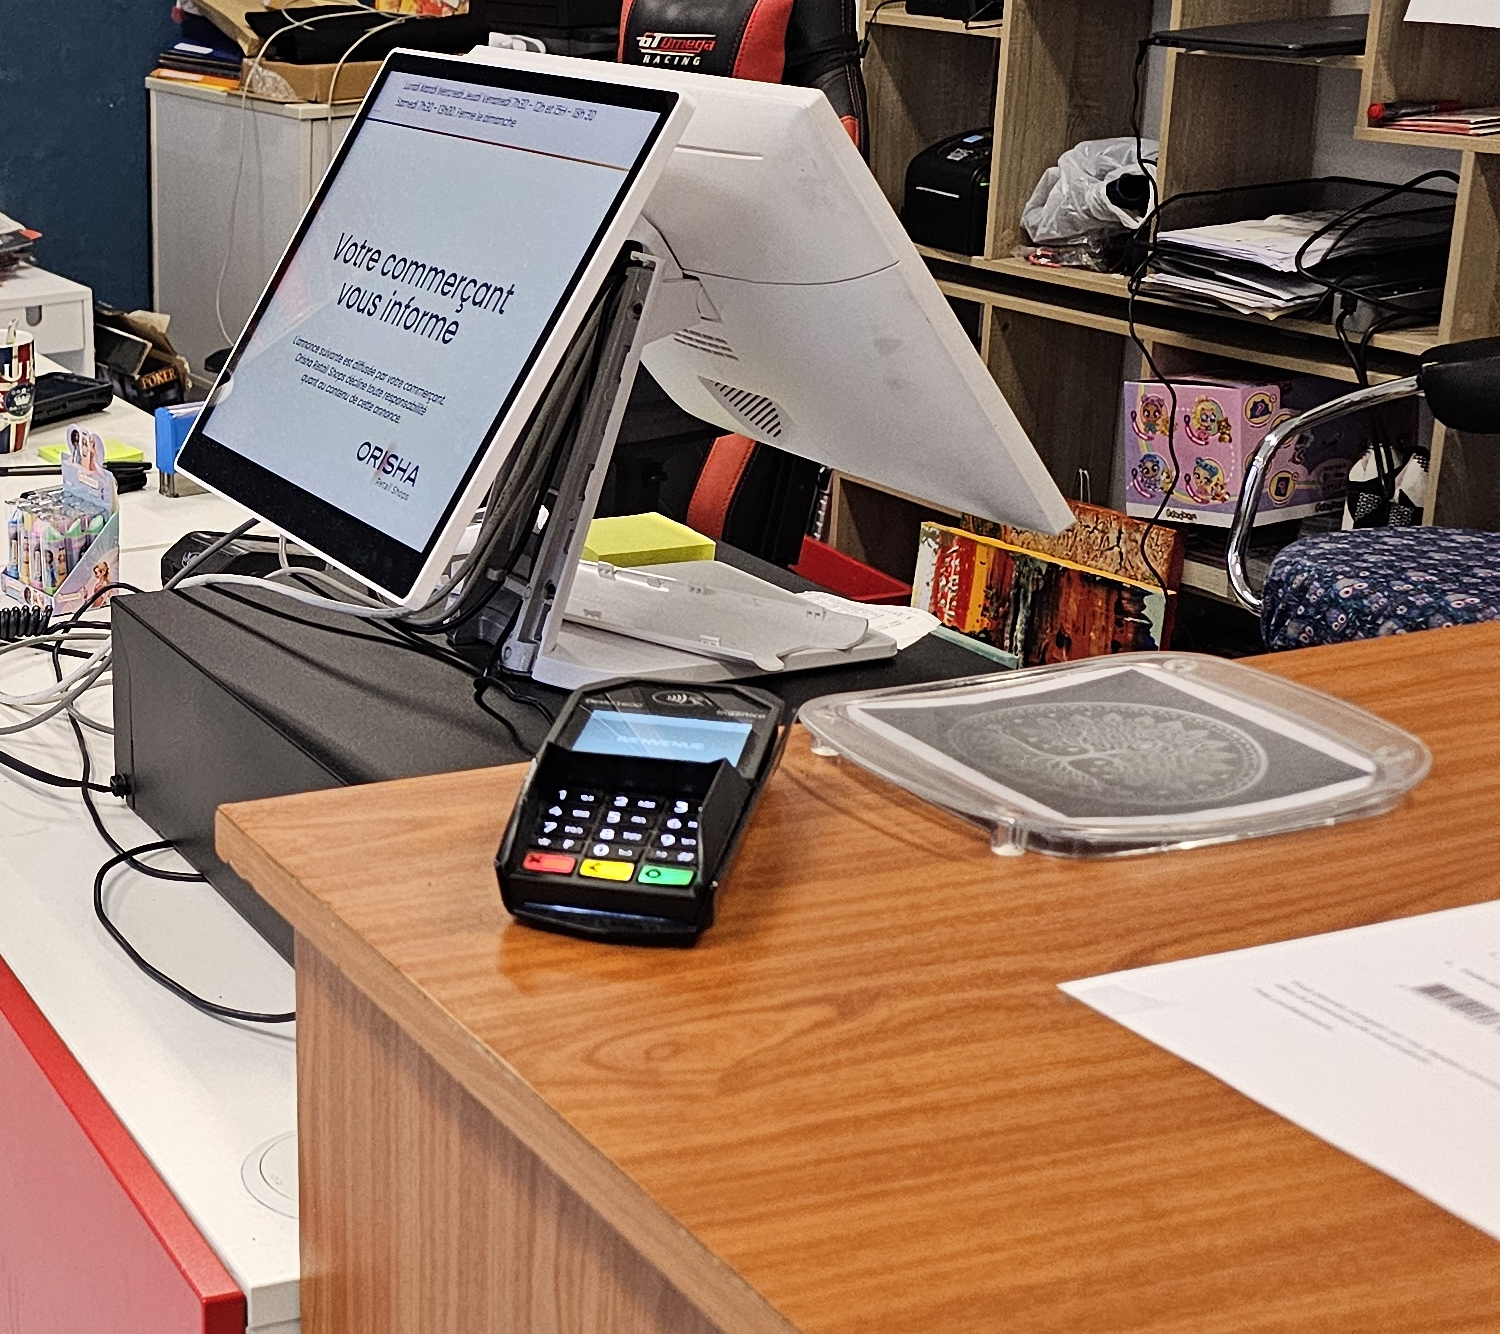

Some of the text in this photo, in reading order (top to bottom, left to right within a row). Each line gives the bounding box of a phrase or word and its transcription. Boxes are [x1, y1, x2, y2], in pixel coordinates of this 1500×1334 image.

[642, 54, 701, 66] RACING
[660, 37, 717, 53] Omega
[333, 232, 516, 315] Votre commerçant
[337, 282, 460, 345] vous informe
[141, 368, 177, 390] POKER
[356, 441, 420, 488] ORISHA
